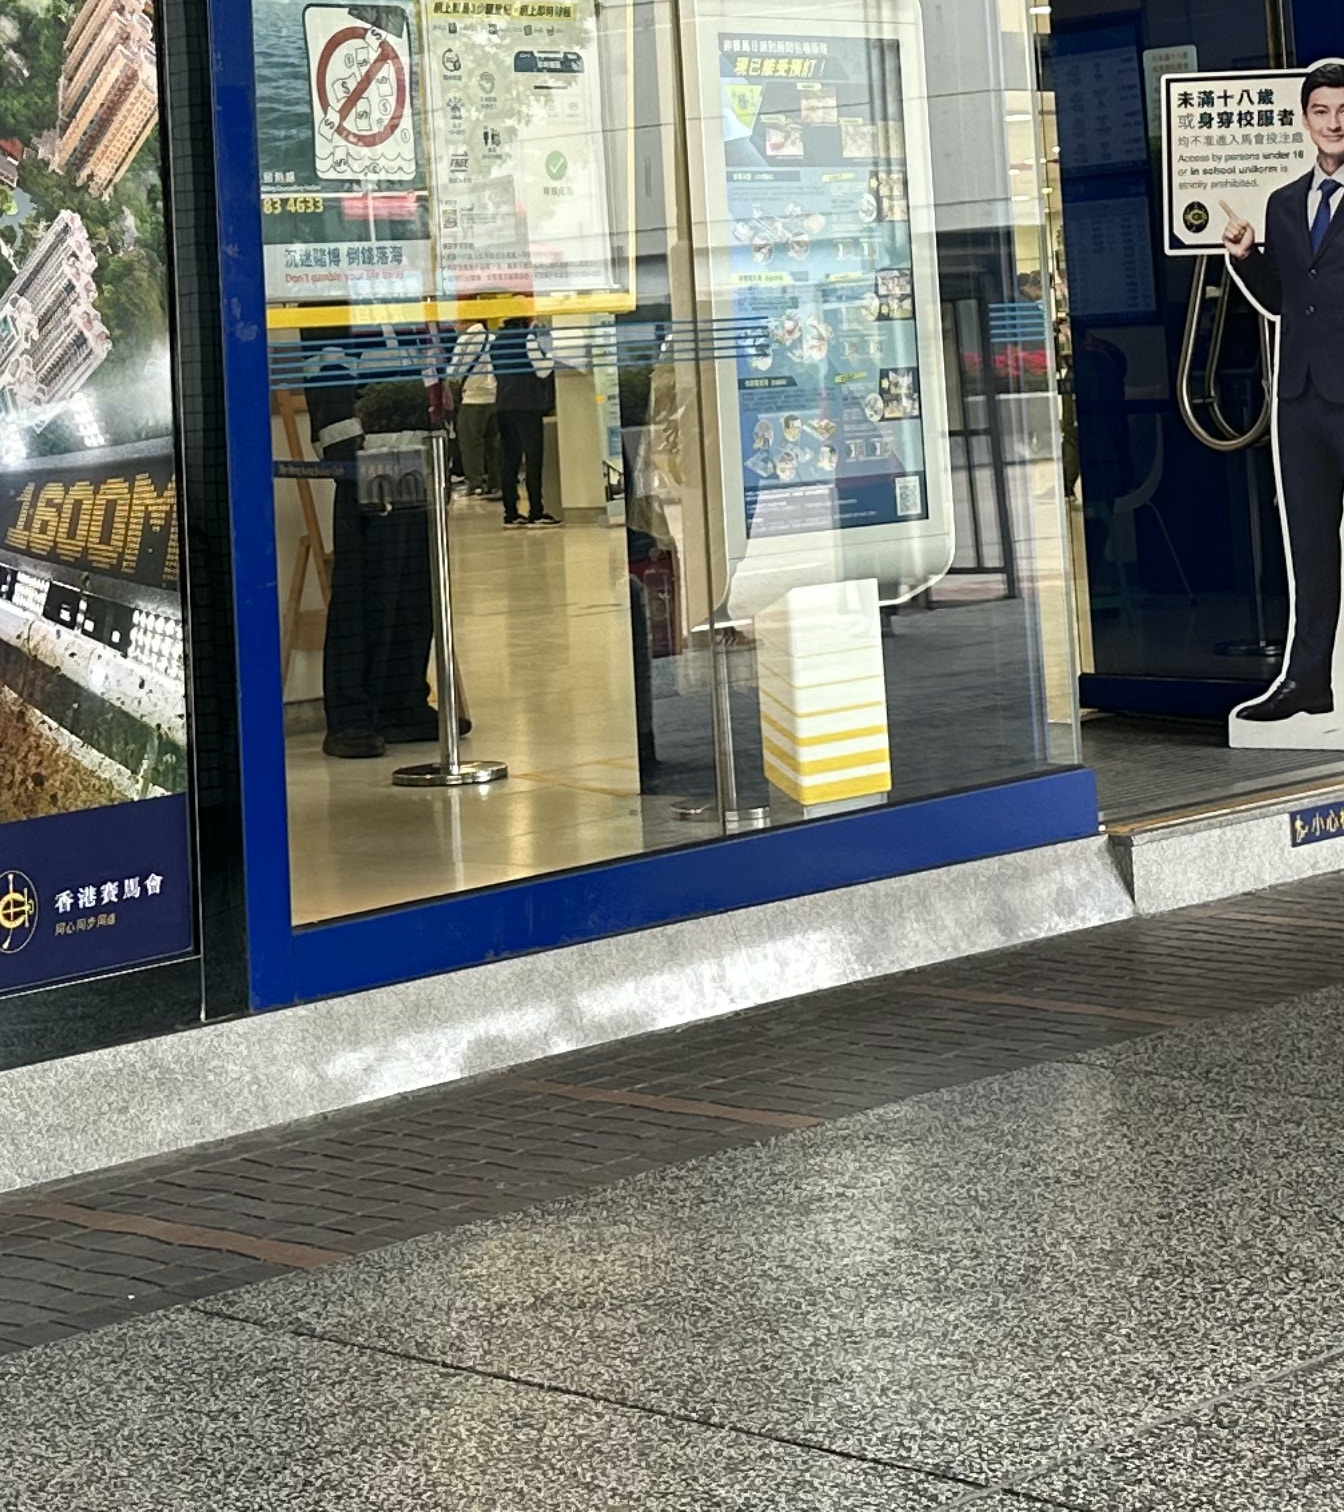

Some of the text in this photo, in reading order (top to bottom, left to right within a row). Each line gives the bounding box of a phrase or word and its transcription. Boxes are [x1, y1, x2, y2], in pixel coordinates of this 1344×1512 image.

[1177, 88, 1275, 108] 未滿十八歲
[1177, 108, 1295, 129] 或身穿校服者
[1178, 149, 1304, 163] Access by persons under 18
[1177, 163, 1288, 177] or in school uniform is
[285, 197, 324, 214] 4633
[3, 472, 179, 581] 1600M
[54, 872, 164, 913] 香港賽馬會
